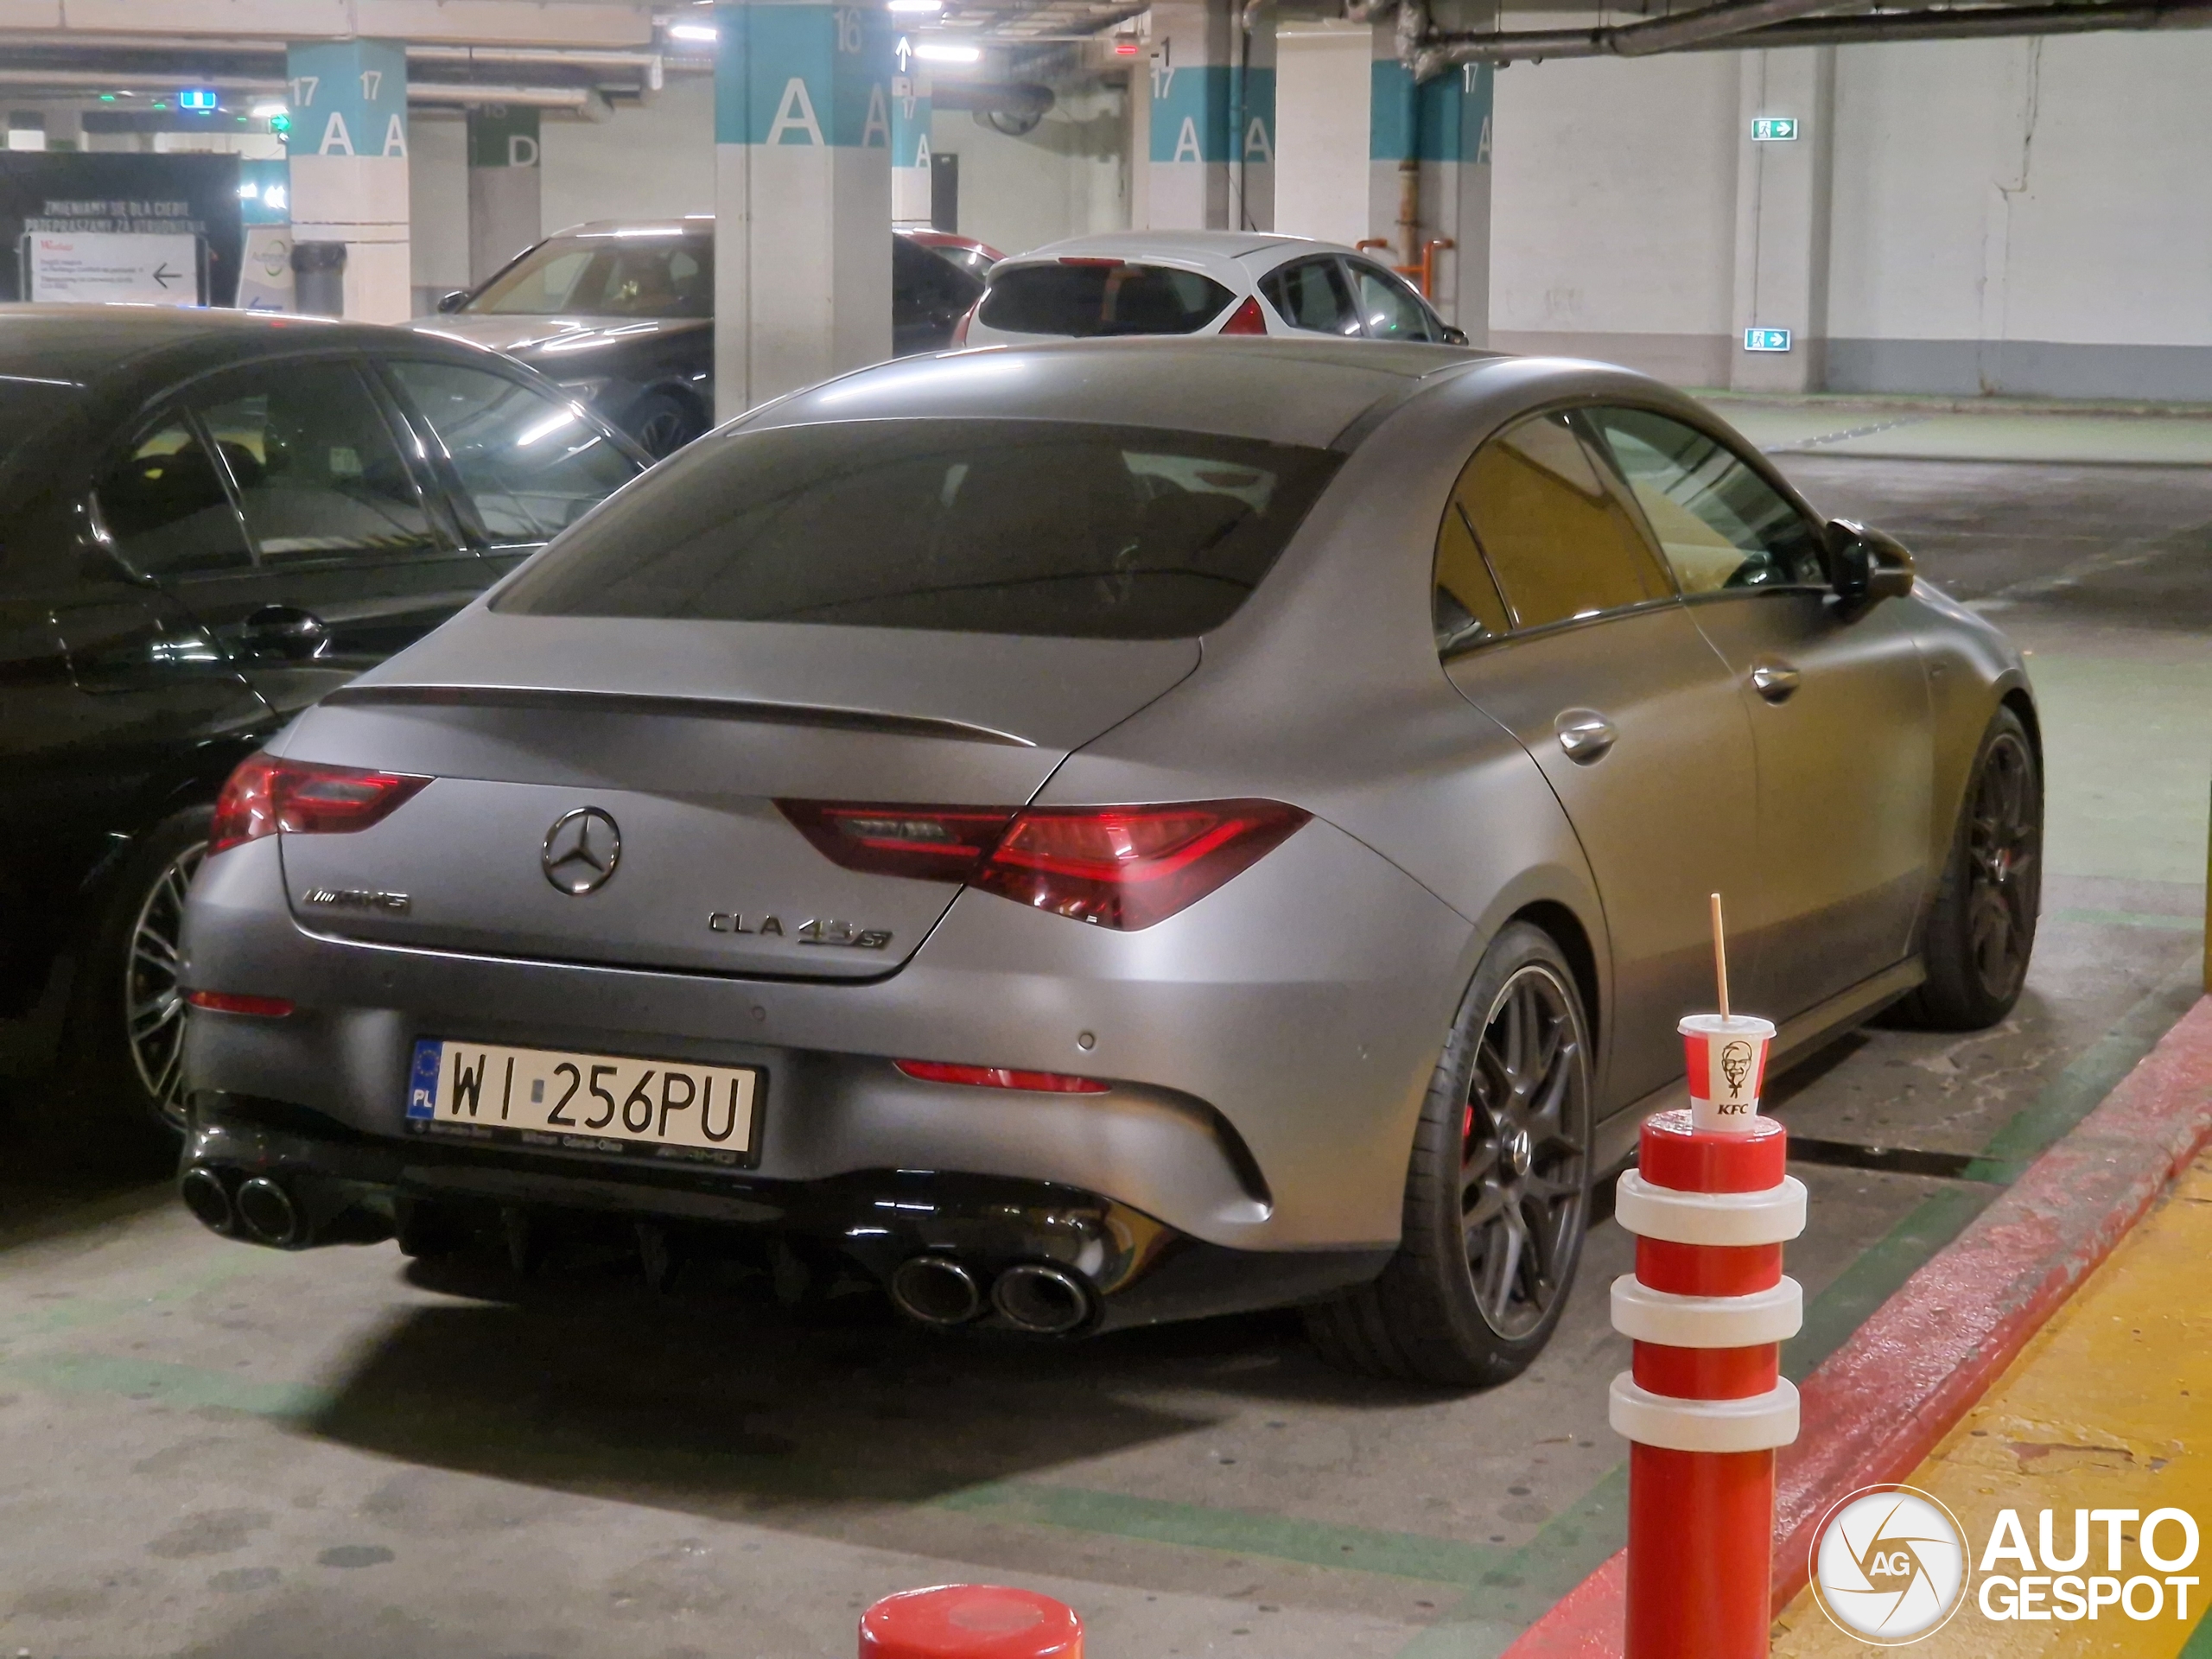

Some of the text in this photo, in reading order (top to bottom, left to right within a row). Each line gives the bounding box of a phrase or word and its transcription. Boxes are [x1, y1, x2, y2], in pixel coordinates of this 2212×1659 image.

[833, 8, 861, 53] 16
[288, 76, 320, 107] 17
[359, 70, 382, 100] 17
[1150, 67, 1174, 99] 17
[1463, 62, 1478, 93] 17
[766, 77, 825, 145] A
[861, 83, 891, 147] A
[902, 97, 916, 119] 17
[318, 111, 354, 156] A
[382, 113, 408, 157] A
[508, 135, 539, 167] D
[915, 133, 931, 168] A
[1173, 116, 1202, 162] A
[1245, 116, 1274, 163] A
[1477, 115, 1492, 163] A
[709, 912, 785, 937] CLA
[413, 1089, 432, 1109] PL
[451, 1052, 740, 1142] WI 256PU
[1717, 1103, 1749, 1116] KFC
